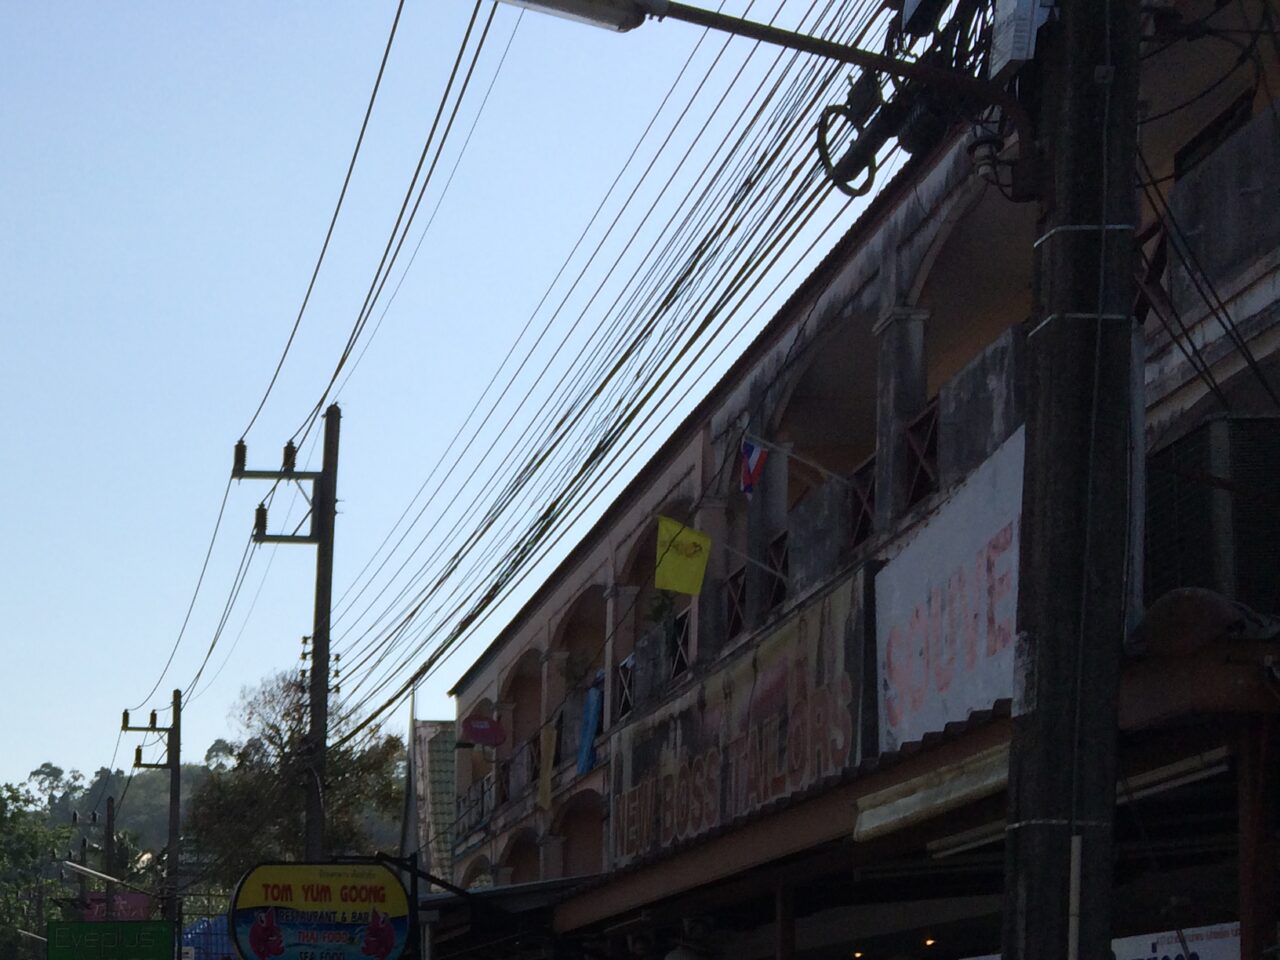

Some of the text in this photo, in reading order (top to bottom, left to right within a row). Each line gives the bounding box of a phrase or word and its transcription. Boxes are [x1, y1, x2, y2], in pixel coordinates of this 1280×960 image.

[614, 672, 854, 856] NEW BOSS TAILORS
[262, 884, 386, 903] TOM YUM GOONG
[279, 911, 369, 923] RESTAURANT & BAR
[298, 931, 348, 944] THAI FOOD
